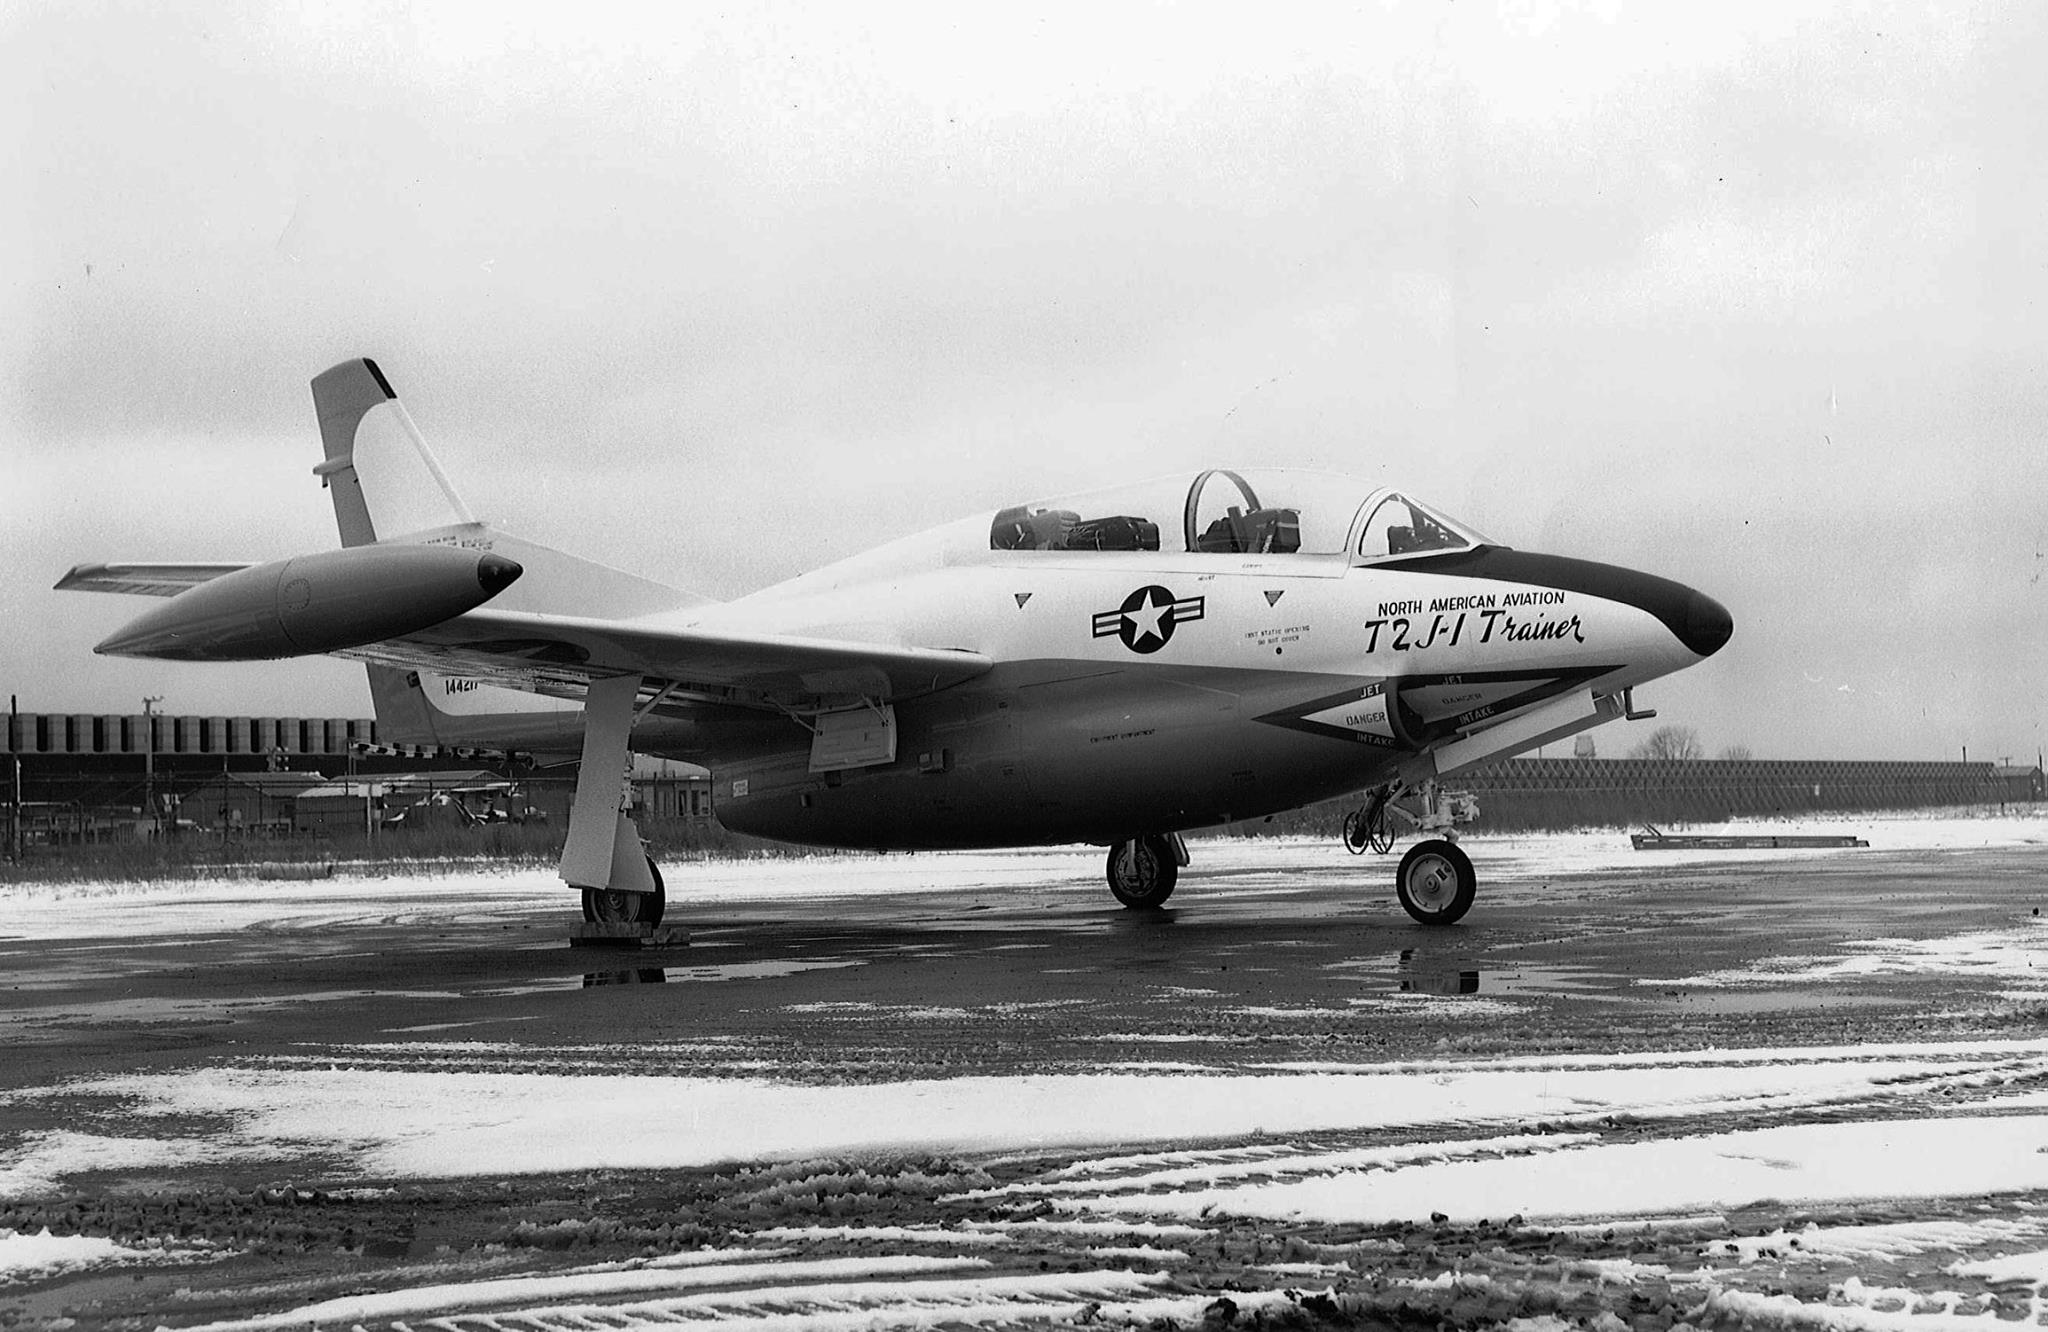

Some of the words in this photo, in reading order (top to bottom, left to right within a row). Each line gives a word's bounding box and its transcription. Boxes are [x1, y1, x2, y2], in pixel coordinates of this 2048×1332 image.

[1378, 600, 1422, 616] NORTH
[1429, 595, 1496, 612] AMERICAN
[1502, 592, 1565, 607] AVIATION
[1479, 610, 1585, 644] Trainer
[1443, 675, 1463, 686] JET
[1360, 684, 1380, 699] JET
[1346, 711, 1386, 726] DANGER
[1458, 705, 1495, 726] INTAKE
